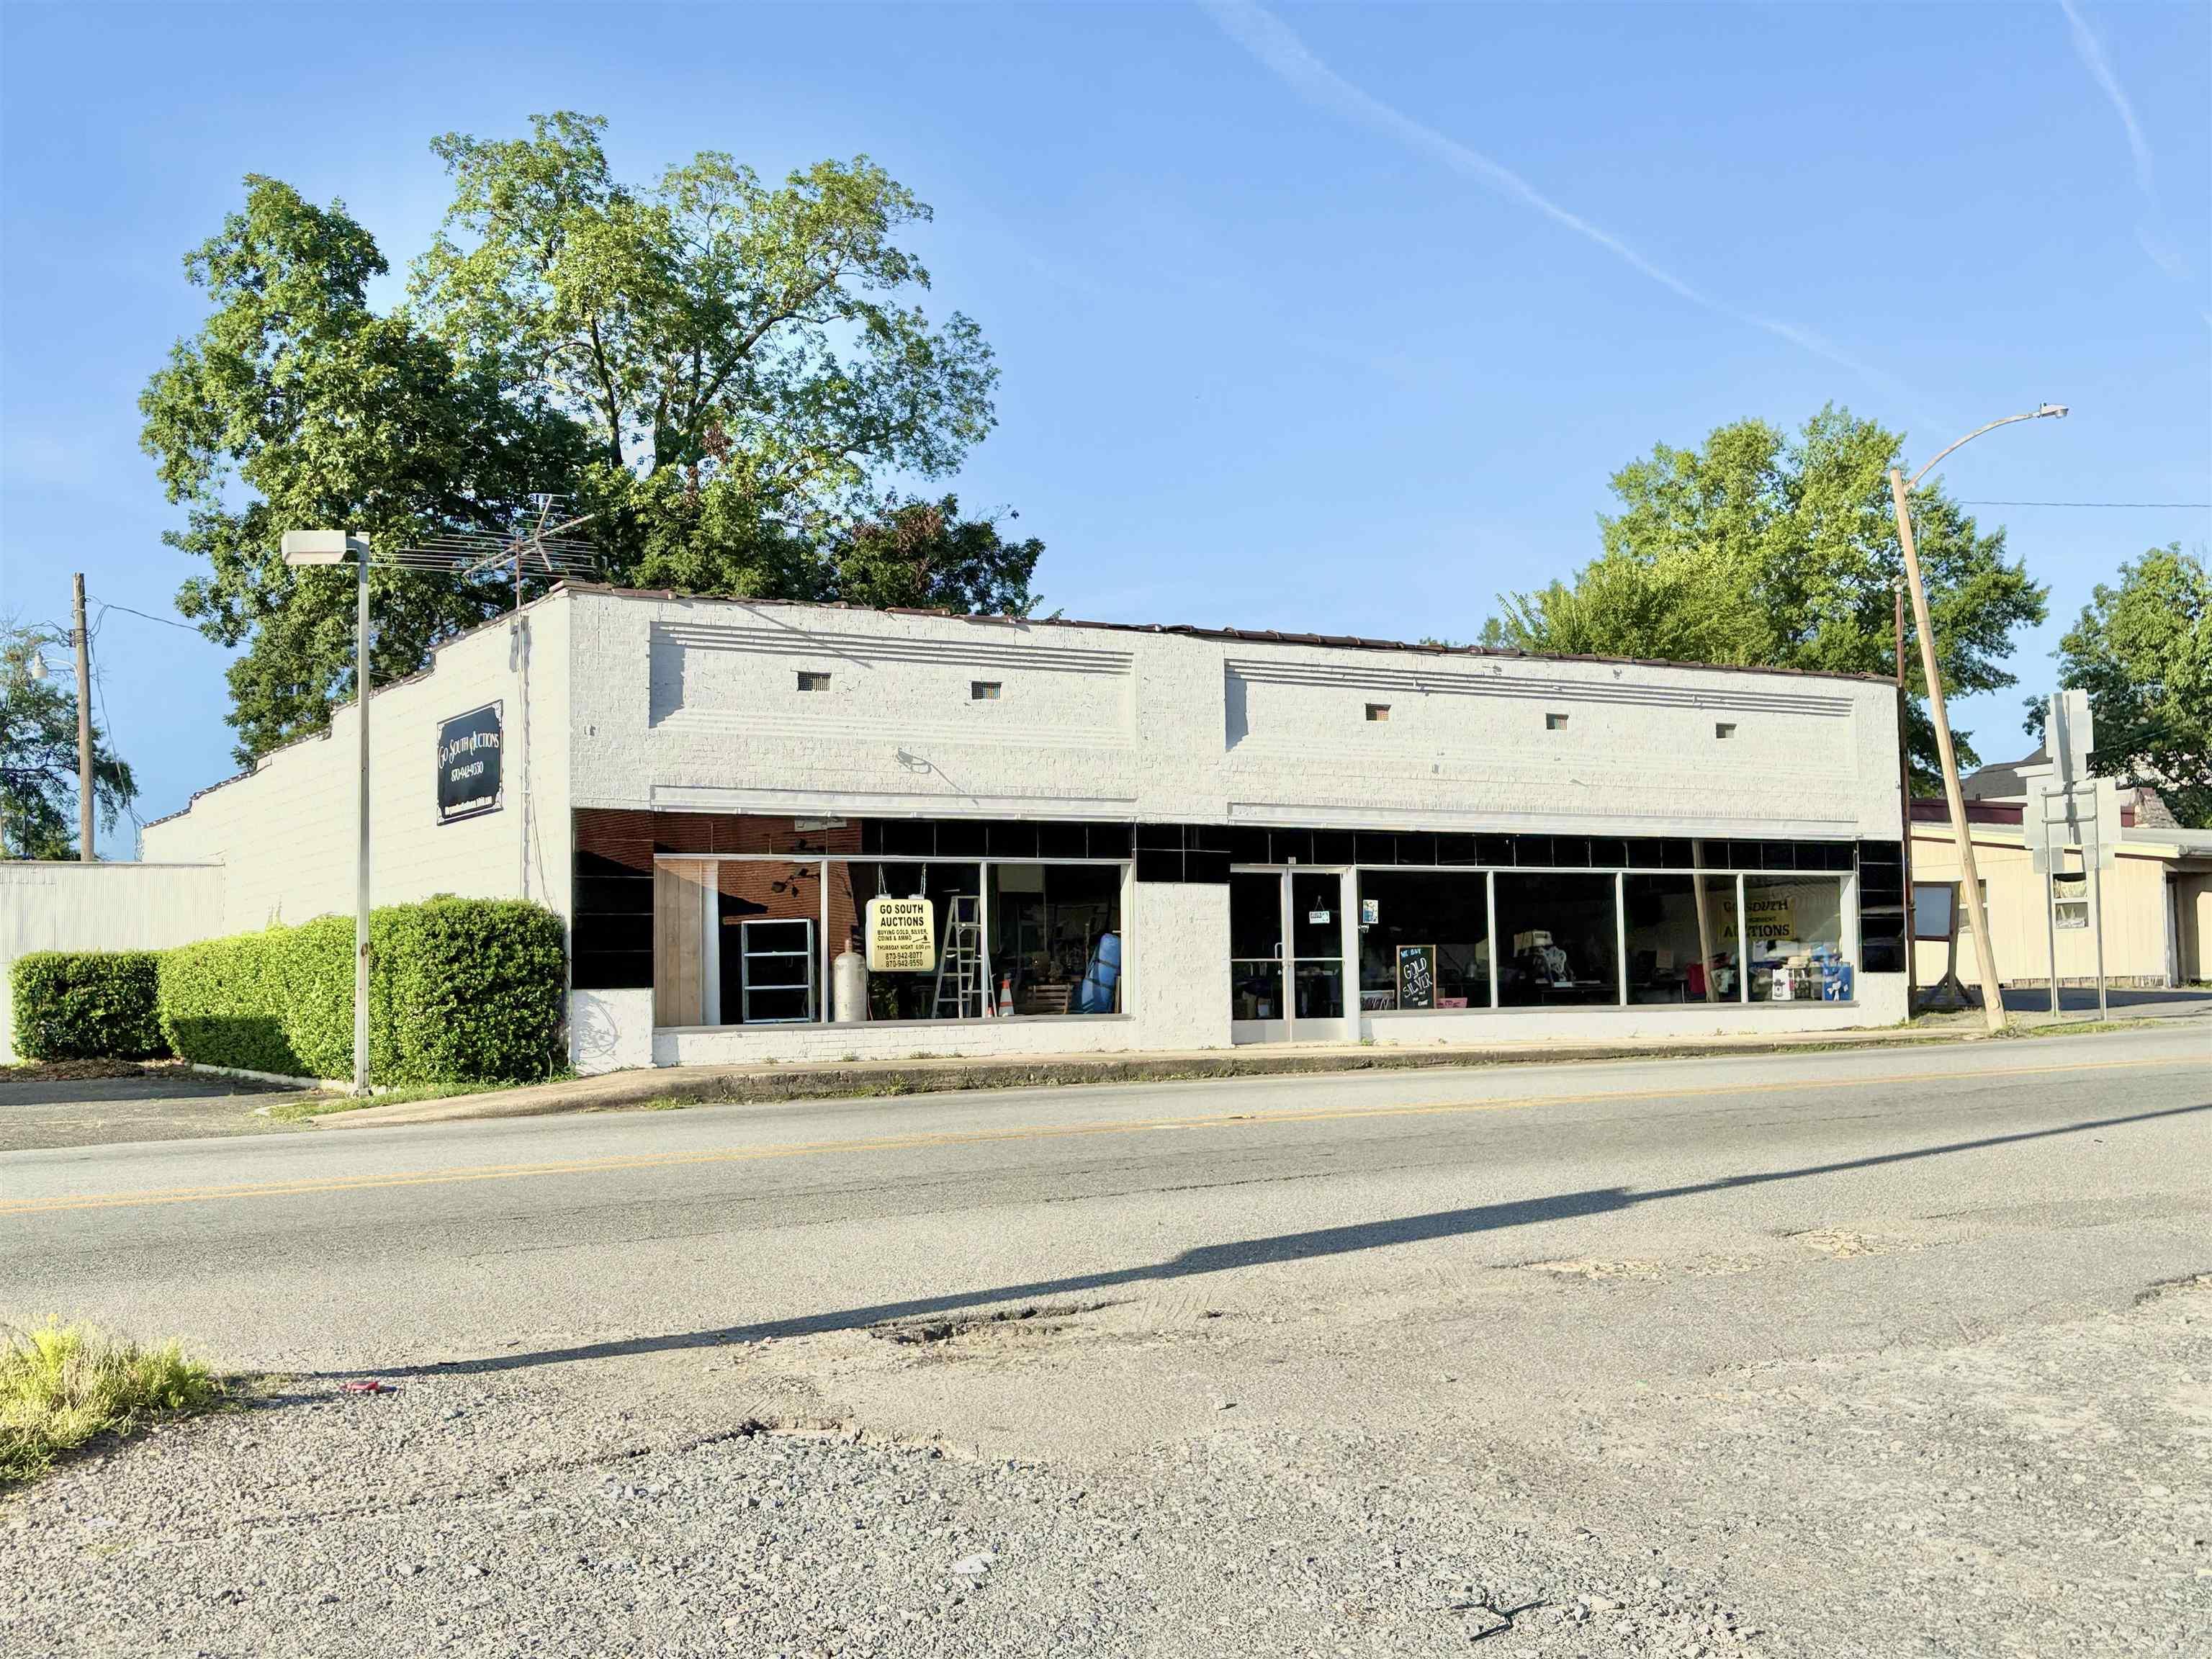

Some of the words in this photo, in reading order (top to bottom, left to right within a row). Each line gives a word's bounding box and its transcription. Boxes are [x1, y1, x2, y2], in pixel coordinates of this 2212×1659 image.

[880, 904, 891, 914] GO
[894, 904, 923, 914] SOUTH
[881, 917, 924, 927] AUCTIONS
[1403, 957, 1427, 980] GOLD
[1403, 972, 1433, 998] SILVER
